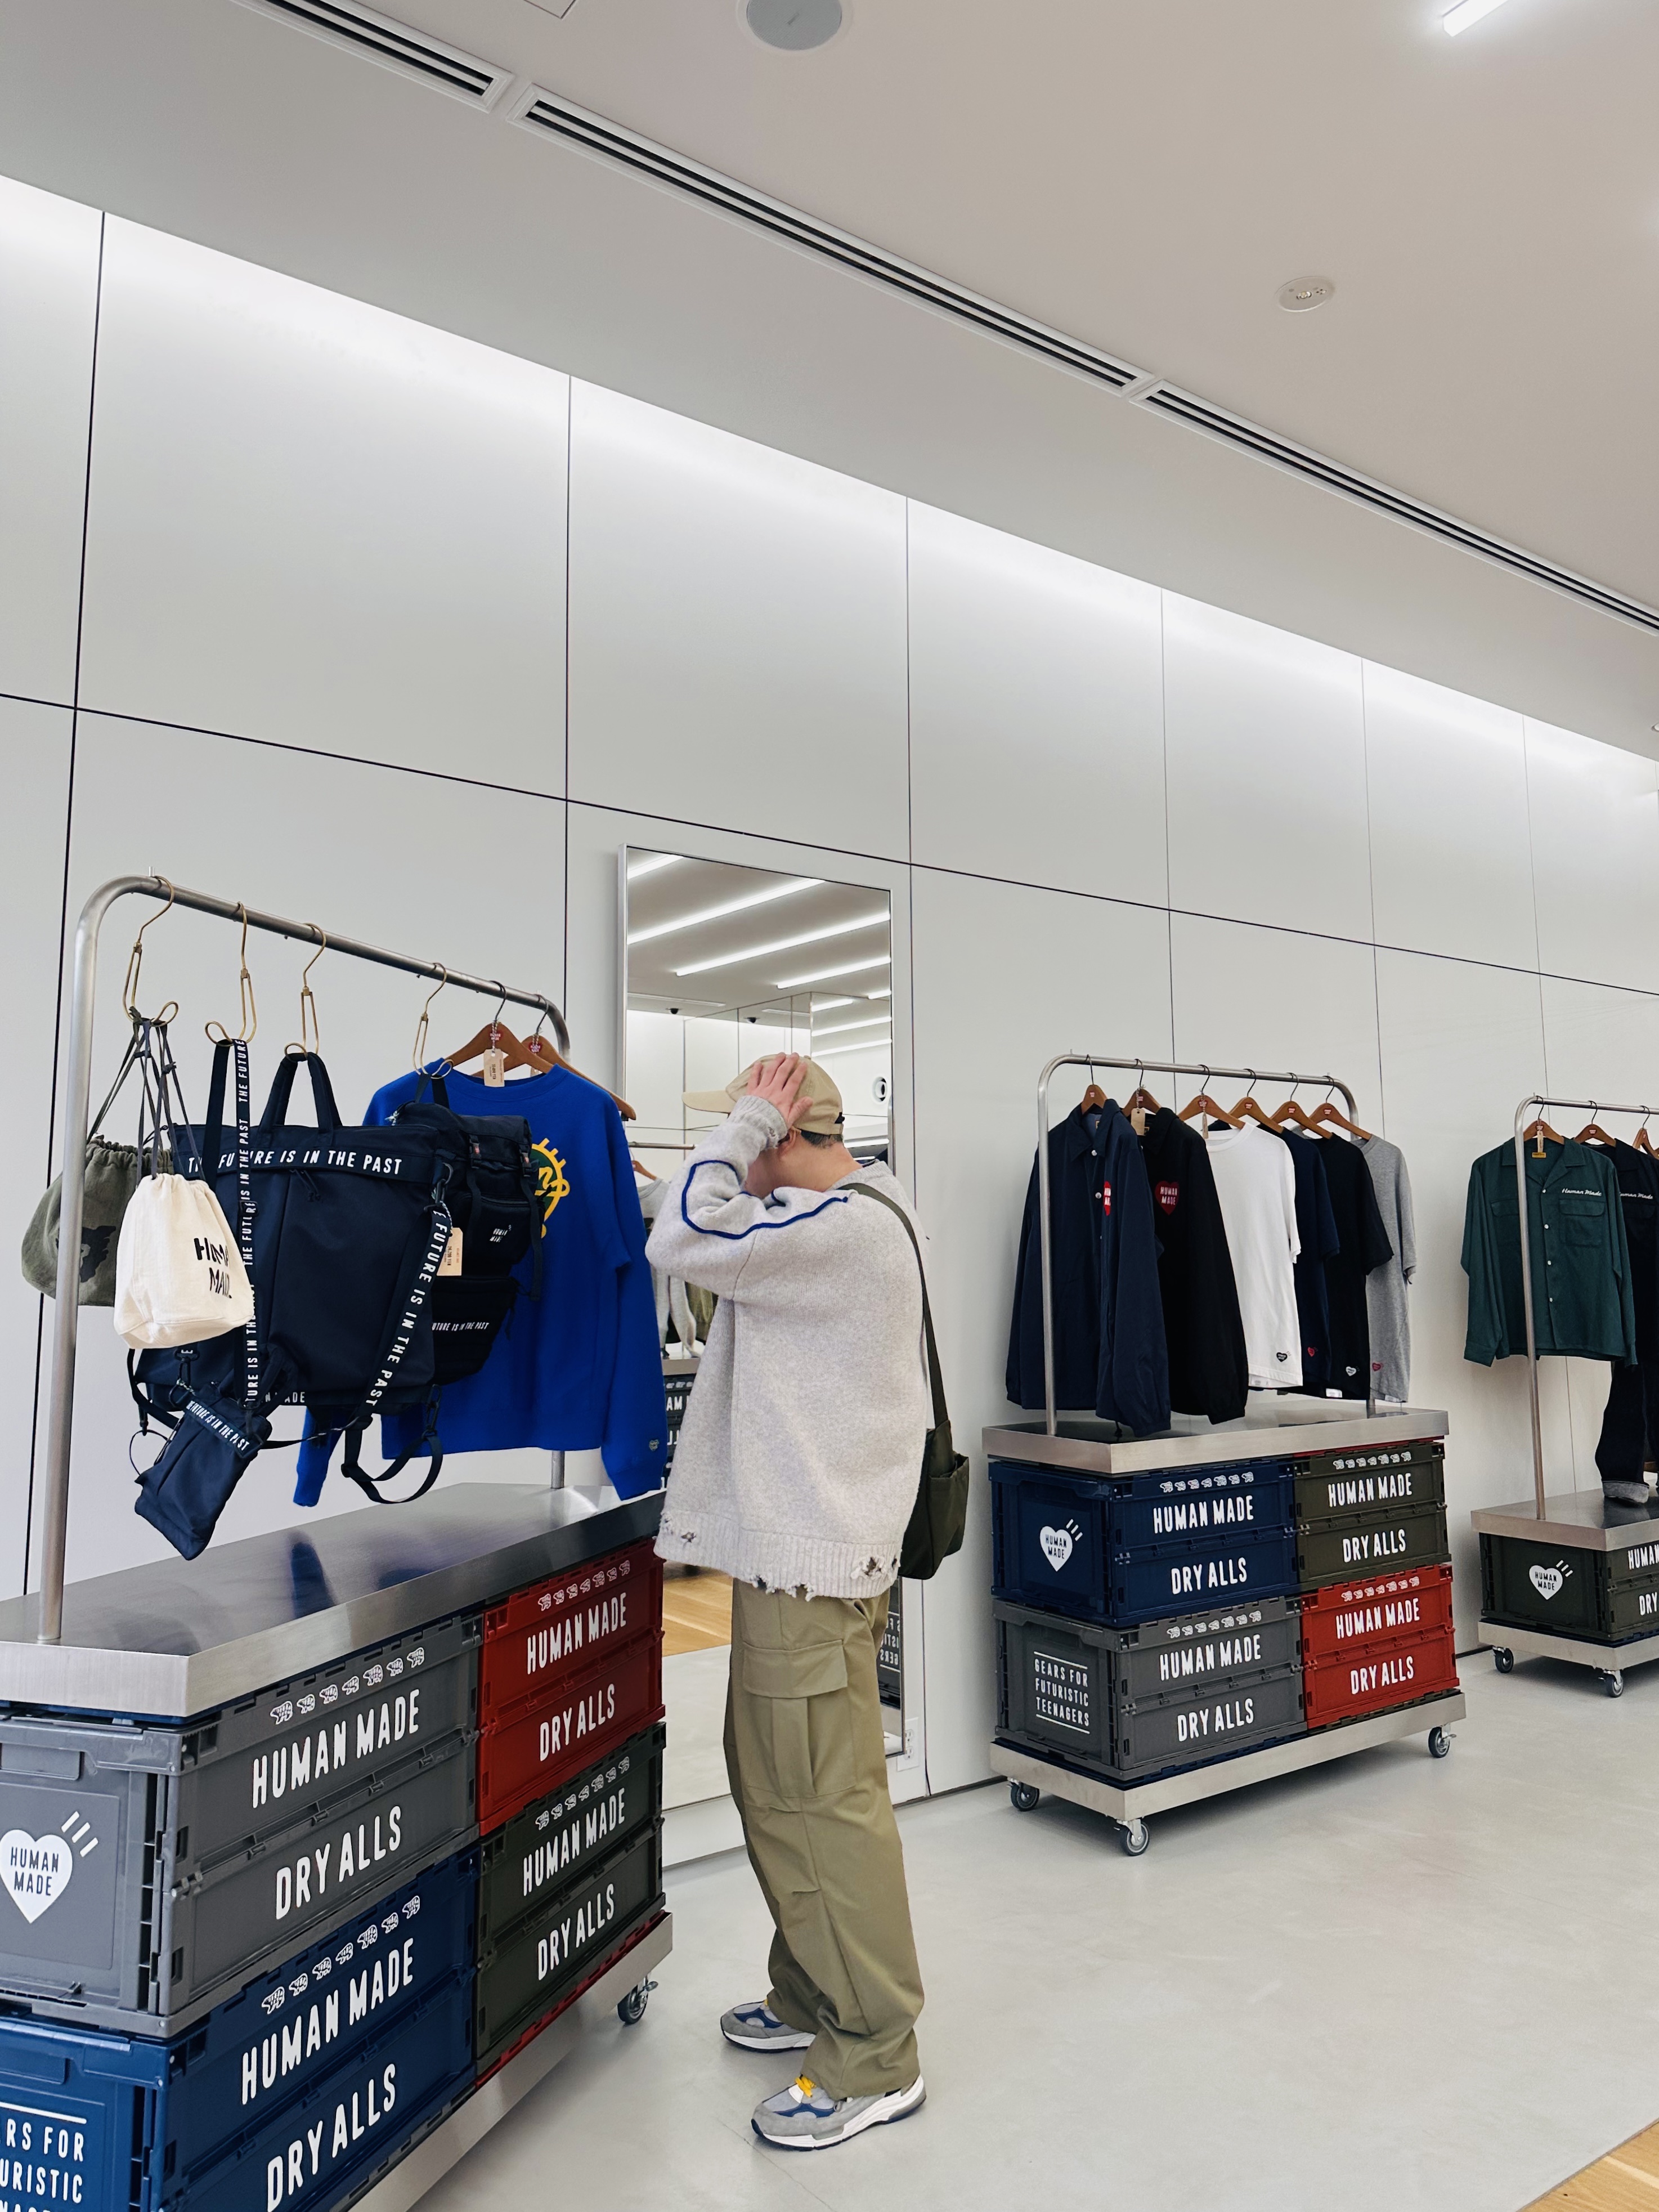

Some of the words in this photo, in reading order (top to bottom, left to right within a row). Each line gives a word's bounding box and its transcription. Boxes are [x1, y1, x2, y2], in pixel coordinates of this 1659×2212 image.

[235, 1040, 248, 1078] FUTURE
[238, 1083, 248, 1102] THE
[239, 1118, 249, 1144] PAST
[218, 1150, 275, 1168] FURE
[280, 1150, 296, 1163] IS
[303, 1150, 319, 1164] IN
[328, 1150, 356, 1167] THE
[363, 1154, 402, 1175] PAST
[239, 1149, 249, 1168] THE
[240, 1173, 249, 1185] IN
[1160, 1186, 1177, 1195] HUMAN
[240, 1190, 250, 1200] IS
[243, 1247, 253, 1266] THE
[419, 1223, 447, 1282] FUTURE
[410, 1289, 425, 1305] IS
[401, 1311, 417, 1329] IN
[432, 1322, 451, 1331] UTURE
[246, 1340, 257, 1351] IN
[387, 1336, 409, 1363] THE
[248, 1358, 258, 1368] IS
[366, 1369, 393, 1406] PAST
[218, 1425, 234, 1438] THE
[1328, 1478, 1374, 1507] HUMAN
[1378, 1473, 1413, 1499] MADE
[1153, 1501, 1208, 1534] HUMAN
[1213, 1495, 1254, 1525] MADE
[1046, 1534, 1066, 1548] HUMAN
[1048, 1546, 1064, 1559] MADE
[1343, 1535, 1369, 1562] DRY
[1374, 1529, 1406, 1557] ALLS
[1628, 1544, 1659, 1570] HUMAN
[1171, 1564, 1202, 1595] DRY
[1208, 1557, 1247, 1588] ALLS
[1535, 1571, 1557, 1582] HUMAN
[1538, 1580, 1554, 1591] MADE
[1639, 1592, 1657, 1615] DRY
[1336, 1605, 1382, 1639] HUMAN
[1385, 1598, 1420, 1628] MADE
[527, 1613, 582, 1675] HUMAN
[588, 1592, 627, 1643] MADE
[1159, 1644, 1214, 1681] HUMAN
[1219, 1634, 1261, 1668] MADE
[1035, 1659, 1065, 1680] GEARS
[1070, 1669, 1088, 1687] FOR
[1351, 1664, 1378, 1695] DRY
[1381, 1656, 1414, 1687] ALLS
[1035, 1678, 1088, 1707] FUTURISTIC
[540, 1707, 572, 1761] DRY
[577, 1683, 615, 1739] ALLS
[1036, 1696, 1089, 1726] TEENAGERS
[1177, 1709, 1208, 1742] DRY
[1214, 1699, 1254, 1732] ALLS
[252, 1721, 346, 1808] HUMAN
[357, 1689, 419, 1759] MADE
[523, 1820, 580, 1896] HUMAN
[585, 1788, 625, 1849] MADE
[10, 1846, 59, 1873] HUMAN
[276, 1843, 330, 1920] DRY
[339, 1806, 401, 1882] ALLS
[14, 1871, 52, 1896] MADE
[537, 1918, 571, 1981] DRY
[575, 1883, 615, 1948] ALLS
[241, 1989, 338, 2105] HUMAN
[349, 1938, 414, 2026] MADE
[43, 2126, 84, 2162] FOR
[267, 2120, 323, 2212] DRY
[332, 2063, 395, 2158] ALLS
